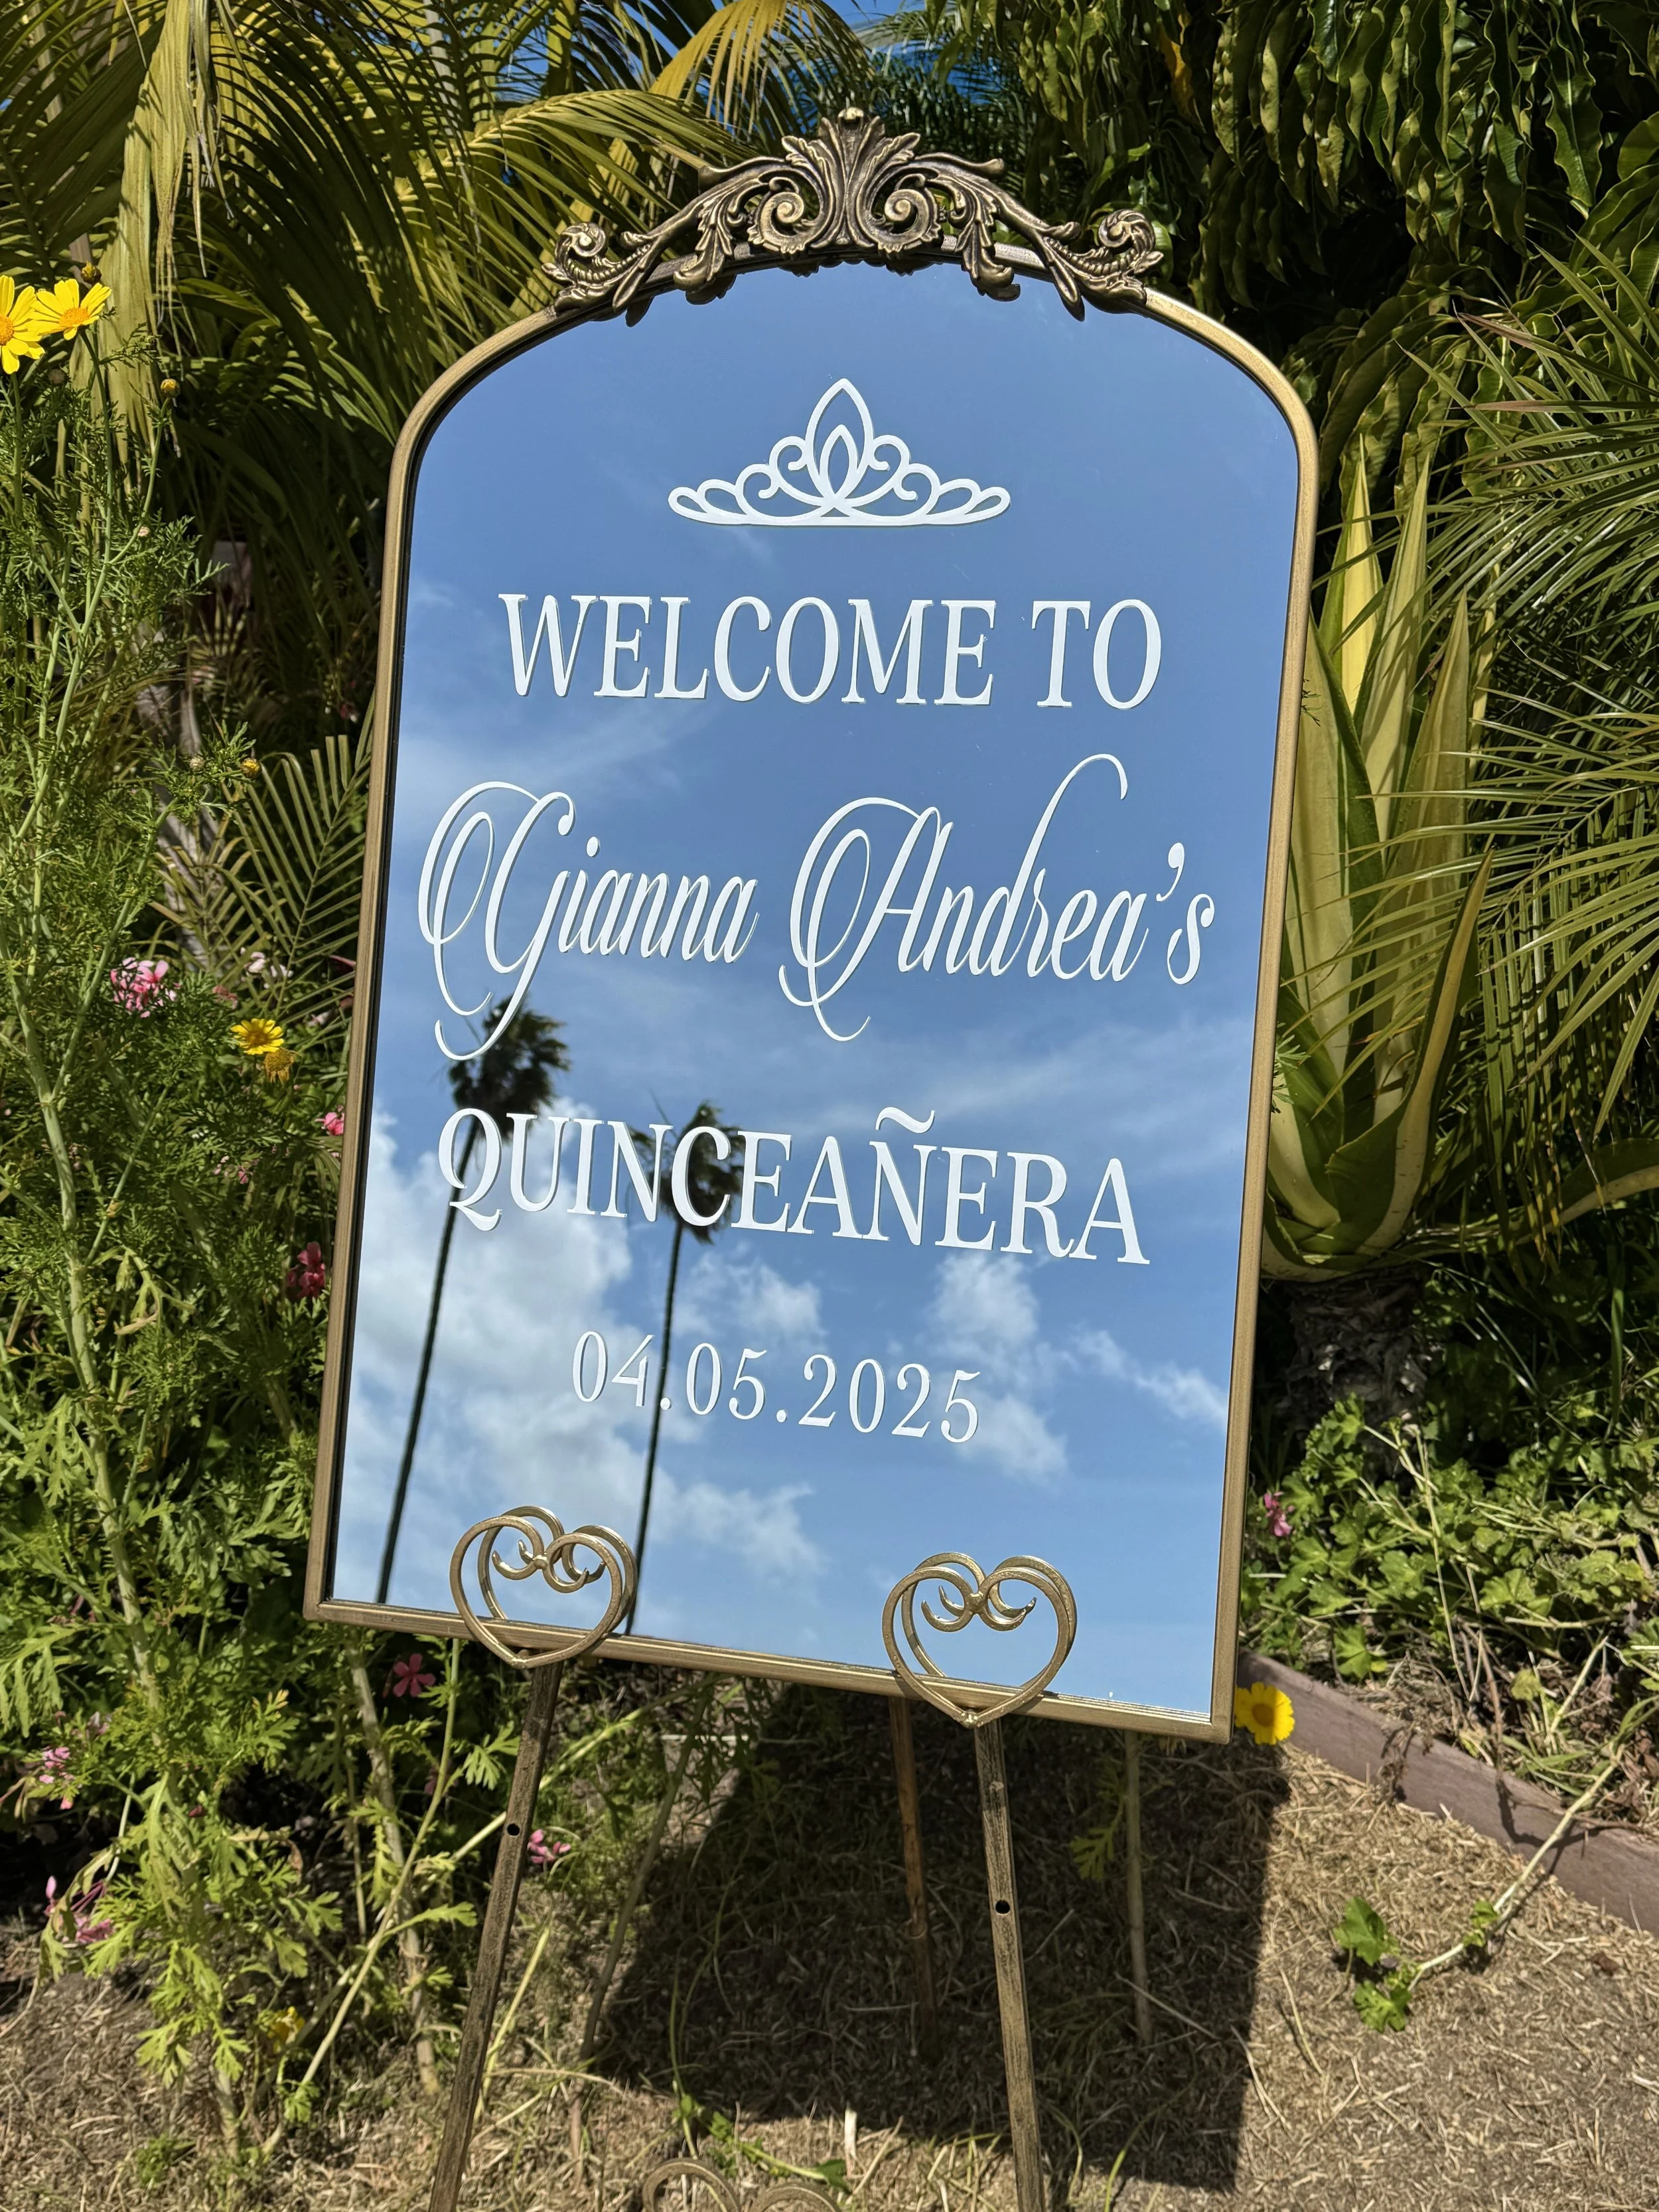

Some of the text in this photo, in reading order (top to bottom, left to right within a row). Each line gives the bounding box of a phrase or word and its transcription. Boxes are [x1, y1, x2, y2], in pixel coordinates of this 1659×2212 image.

[498, 593, 1161, 709] WELCOME TO
[417, 754, 1214, 1060] Gianna Andrea's
[438, 1107, 1150, 1265] QUINCEAÑERA
[572, 1331, 981, 1443] 04.05.2025
